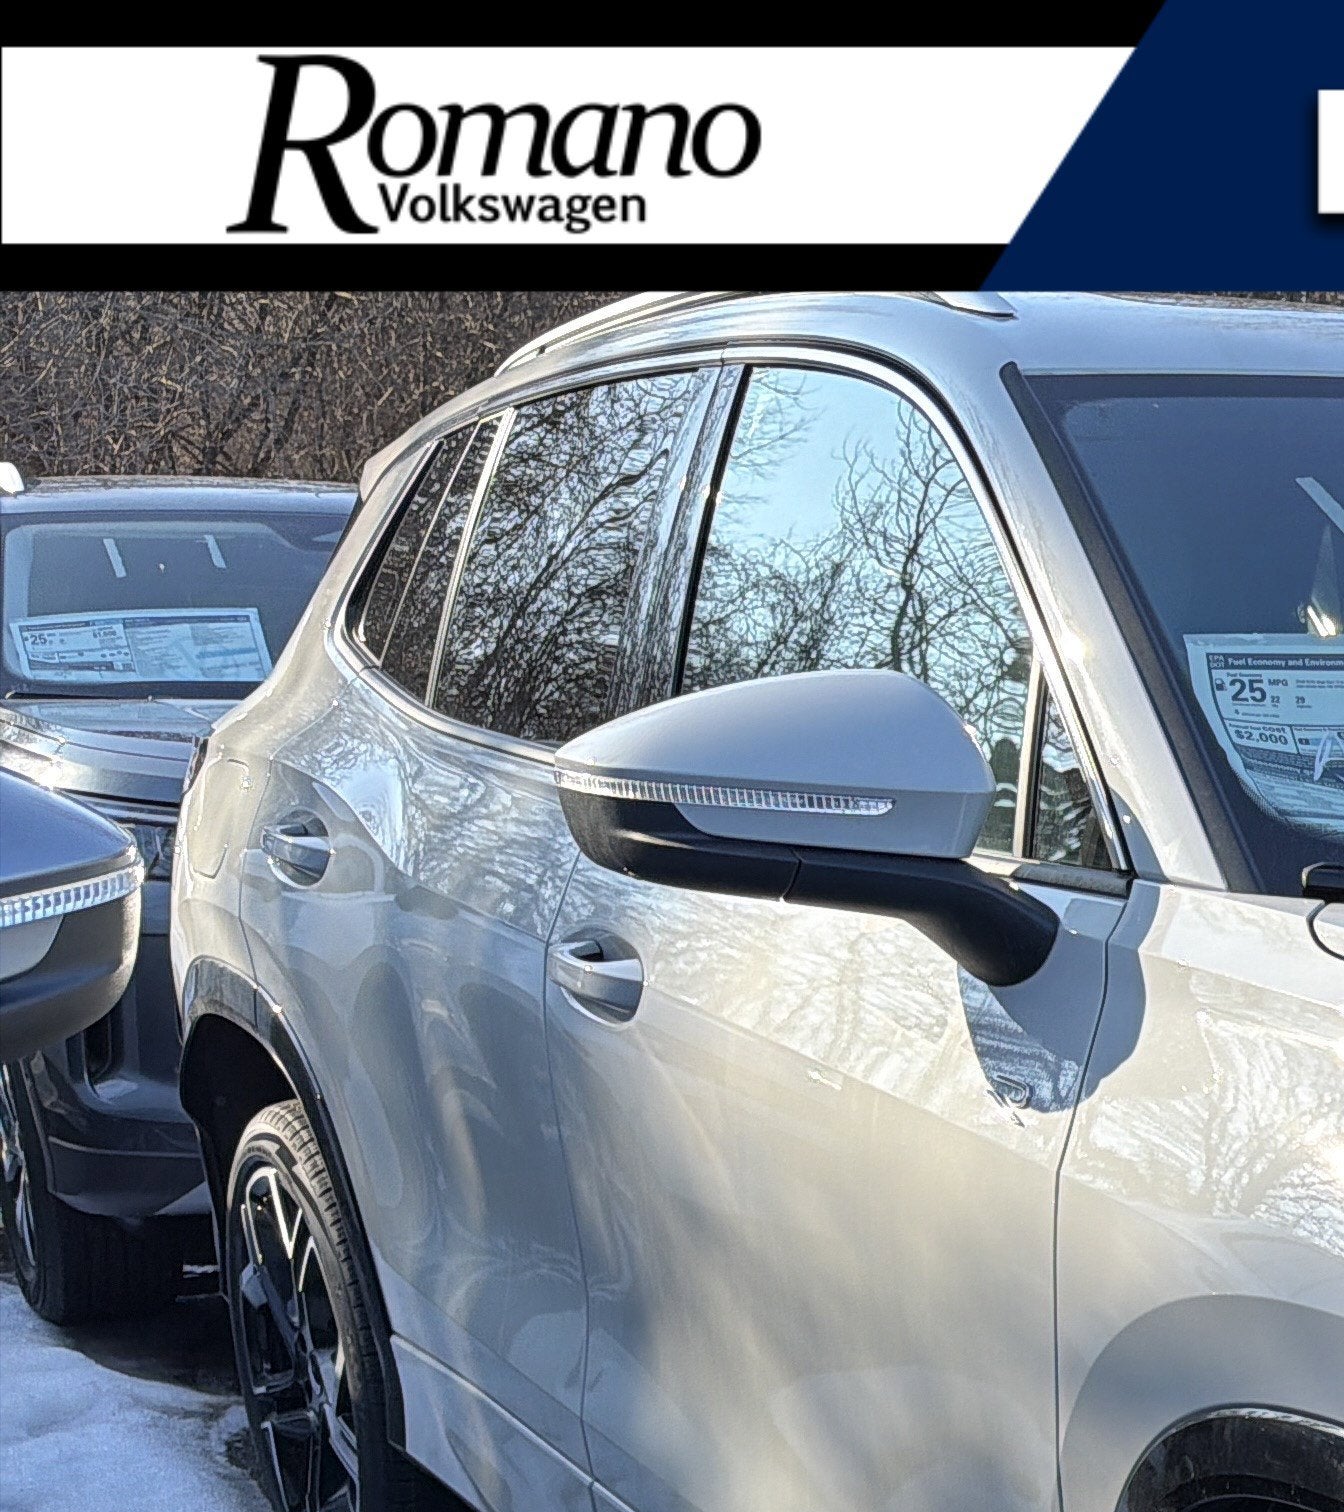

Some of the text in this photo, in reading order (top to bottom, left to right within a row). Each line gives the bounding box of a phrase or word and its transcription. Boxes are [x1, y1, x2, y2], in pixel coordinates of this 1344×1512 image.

[1228, 657, 1247, 666] Fuel
[1248, 658, 1286, 668] Economy
[1287, 658, 1304, 667] and
[1229, 678, 1267, 703] 25
[1267, 678, 1289, 687] MPG
[1234, 728, 1289, 746] $2,000
